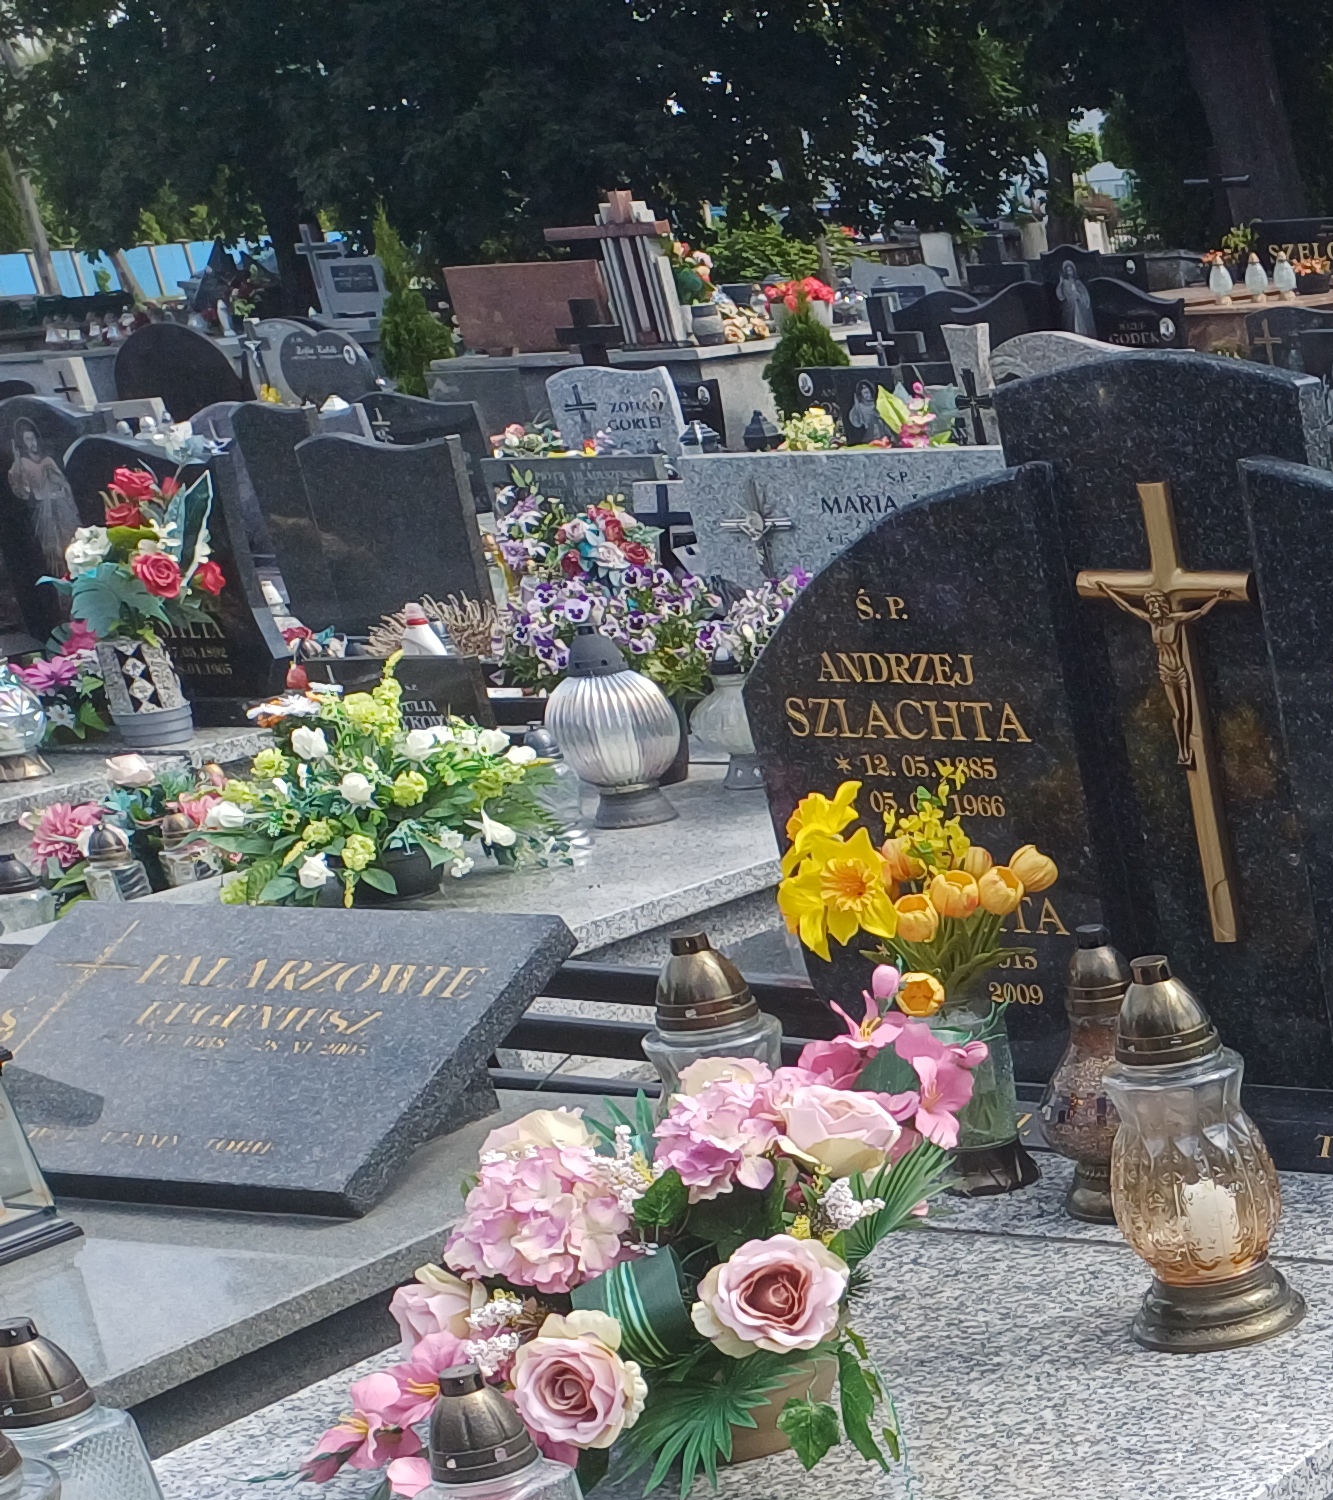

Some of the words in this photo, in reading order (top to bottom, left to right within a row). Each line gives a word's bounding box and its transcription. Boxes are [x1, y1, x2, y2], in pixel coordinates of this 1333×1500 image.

[821, 496, 898, 514] MARIA
[817, 651, 974, 687] ANDRZEJ
[785, 697, 1033, 743] SZLACHTA
[860, 754, 897, 777] 12.
[901, 754, 937, 778] 05.
[949, 794, 1006, 817] 1966
[135, 953, 488, 999] FALARZOWIE
[988, 981, 1044, 1005] 2009
[135, 1000, 383, 1037] EUGENIUSZ
